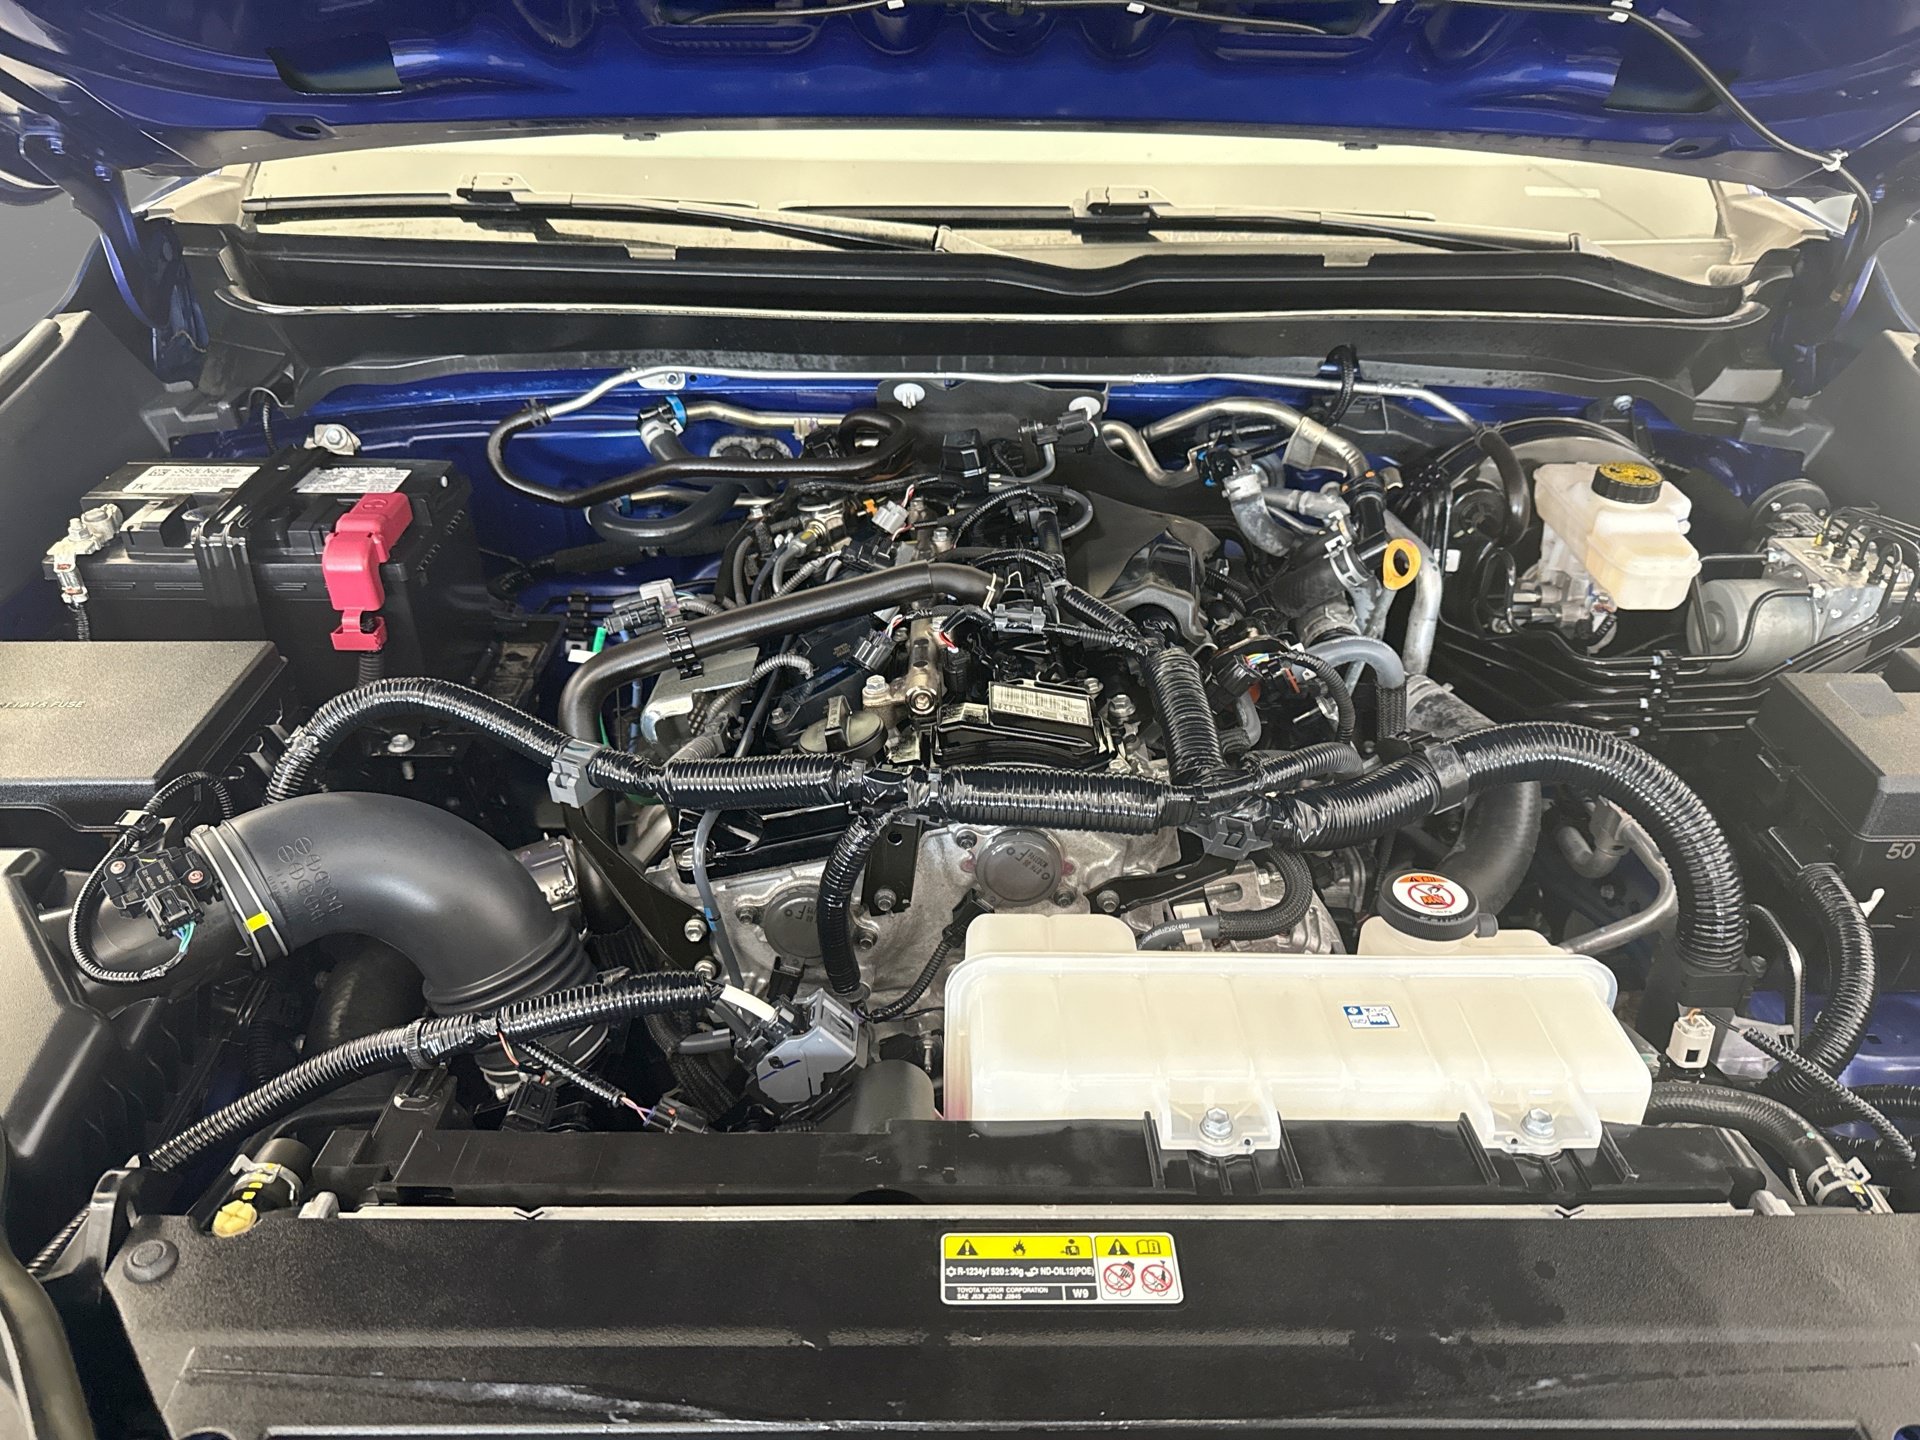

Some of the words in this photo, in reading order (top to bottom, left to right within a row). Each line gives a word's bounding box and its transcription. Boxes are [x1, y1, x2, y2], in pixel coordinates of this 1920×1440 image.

[50, 701, 86, 709] FUSE
[1885, 842, 1916, 860] 50
[957, 1266, 990, 1278] R-1234yf
[1040, 1266, 1094, 1277] ND-OIL12(POE)
[1072, 1288, 1089, 1299] W9
